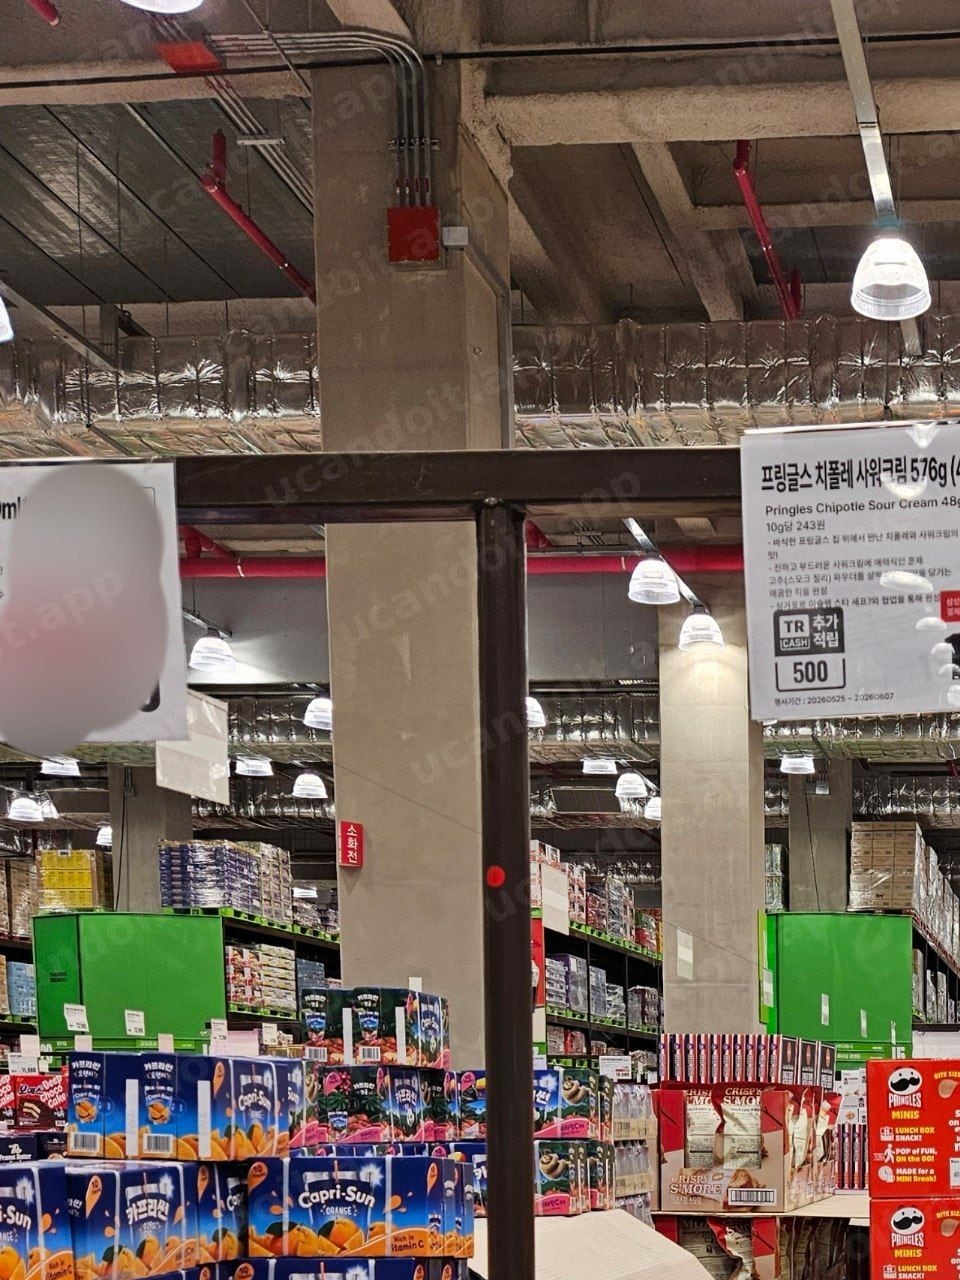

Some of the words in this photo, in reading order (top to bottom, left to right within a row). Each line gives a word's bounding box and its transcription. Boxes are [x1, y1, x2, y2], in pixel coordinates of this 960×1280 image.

[762, 462, 812, 493] 프링글스
[815, 460, 853, 490] 치폴레
[856, 455, 907, 488] 사워크림
[911, 456, 947, 488] 576g
[765, 504, 813, 517] Pringles
[816, 500, 865, 514] Chipotle
[868, 499, 896, 511] Sour
[899, 497, 938, 510] Cream
[766, 521, 793, 533] 10g당
[796, 519, 826, 531] 243원
[784, 620, 804, 633] TR
[812, 613, 839, 631] 추가
[782, 638, 808, 649] CASH
[813, 631, 839, 649] 적립
[793, 660, 828, 683] 500
[346, 824, 358, 864] 소화전
[71, 1060, 101, 1070] 카프리썬
[143, 1060, 174, 1071] 카프리썬
[725, 1087, 762, 1097] CRISPY
[238, 1090, 272, 1112] Capri-Sun
[888, 1093, 922, 1109] PRINGLES
[895, 1126, 918, 1134] LUNCH
[920, 1126, 935, 1134] BOX
[895, 1134, 922, 1142] SNACK!
[671, 1175, 708, 1184] CRISPY
[298, 1184, 376, 1208] Capri-Sun
[670, 1183, 722, 1195] S'MORE
[126, 1198, 170, 1225] 카프리썬
[325, 1206, 352, 1216] ORANGE
[891, 1232, 925, 1248] PRINGLES
[898, 1264, 921, 1272] LUNCH
[922, 1264, 938, 1272] BOX
